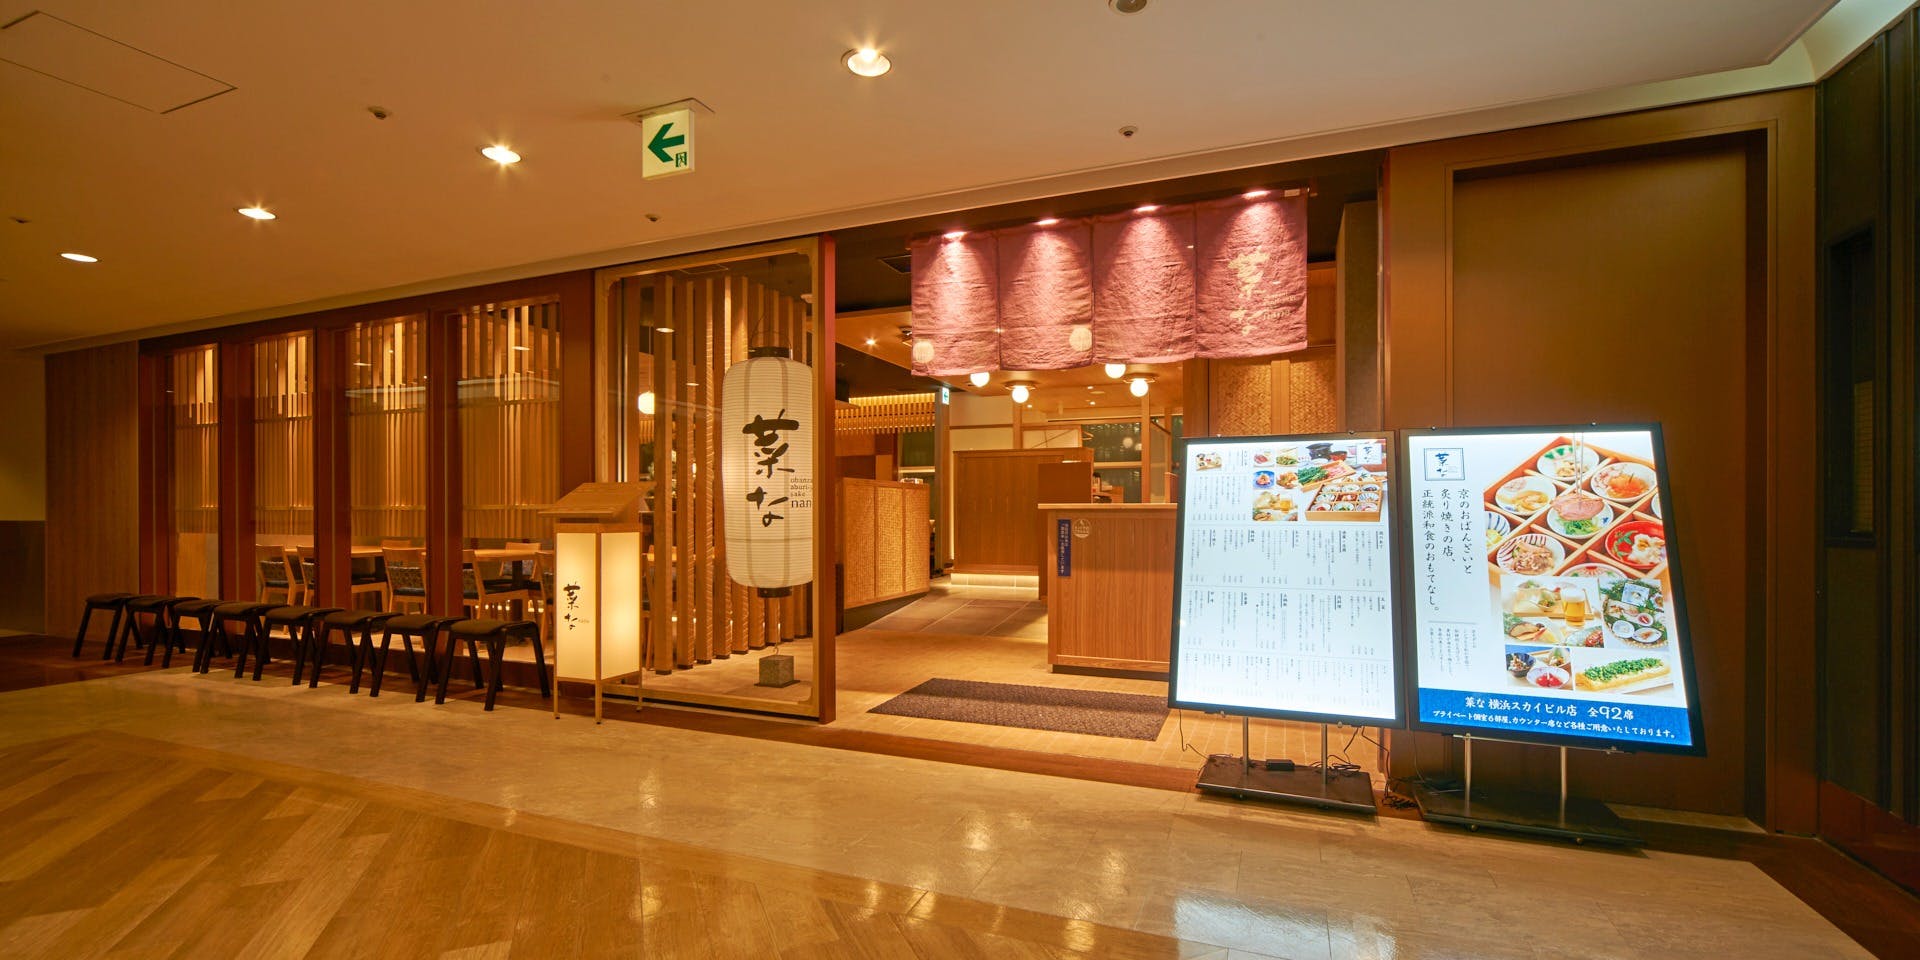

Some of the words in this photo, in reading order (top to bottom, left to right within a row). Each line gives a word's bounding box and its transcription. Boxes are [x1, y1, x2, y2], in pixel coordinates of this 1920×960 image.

[742, 408, 800, 528] 菜な
[1421, 489, 1440, 611] 正統派和食のおもてなし。
[1440, 488, 1456, 563] 炙り焼きの店、
[1457, 488, 1474, 575] 京のおばんざいと
[563, 581, 581, 630] 菜な
[1487, 698, 1578, 717] 横浜スカイビル店
